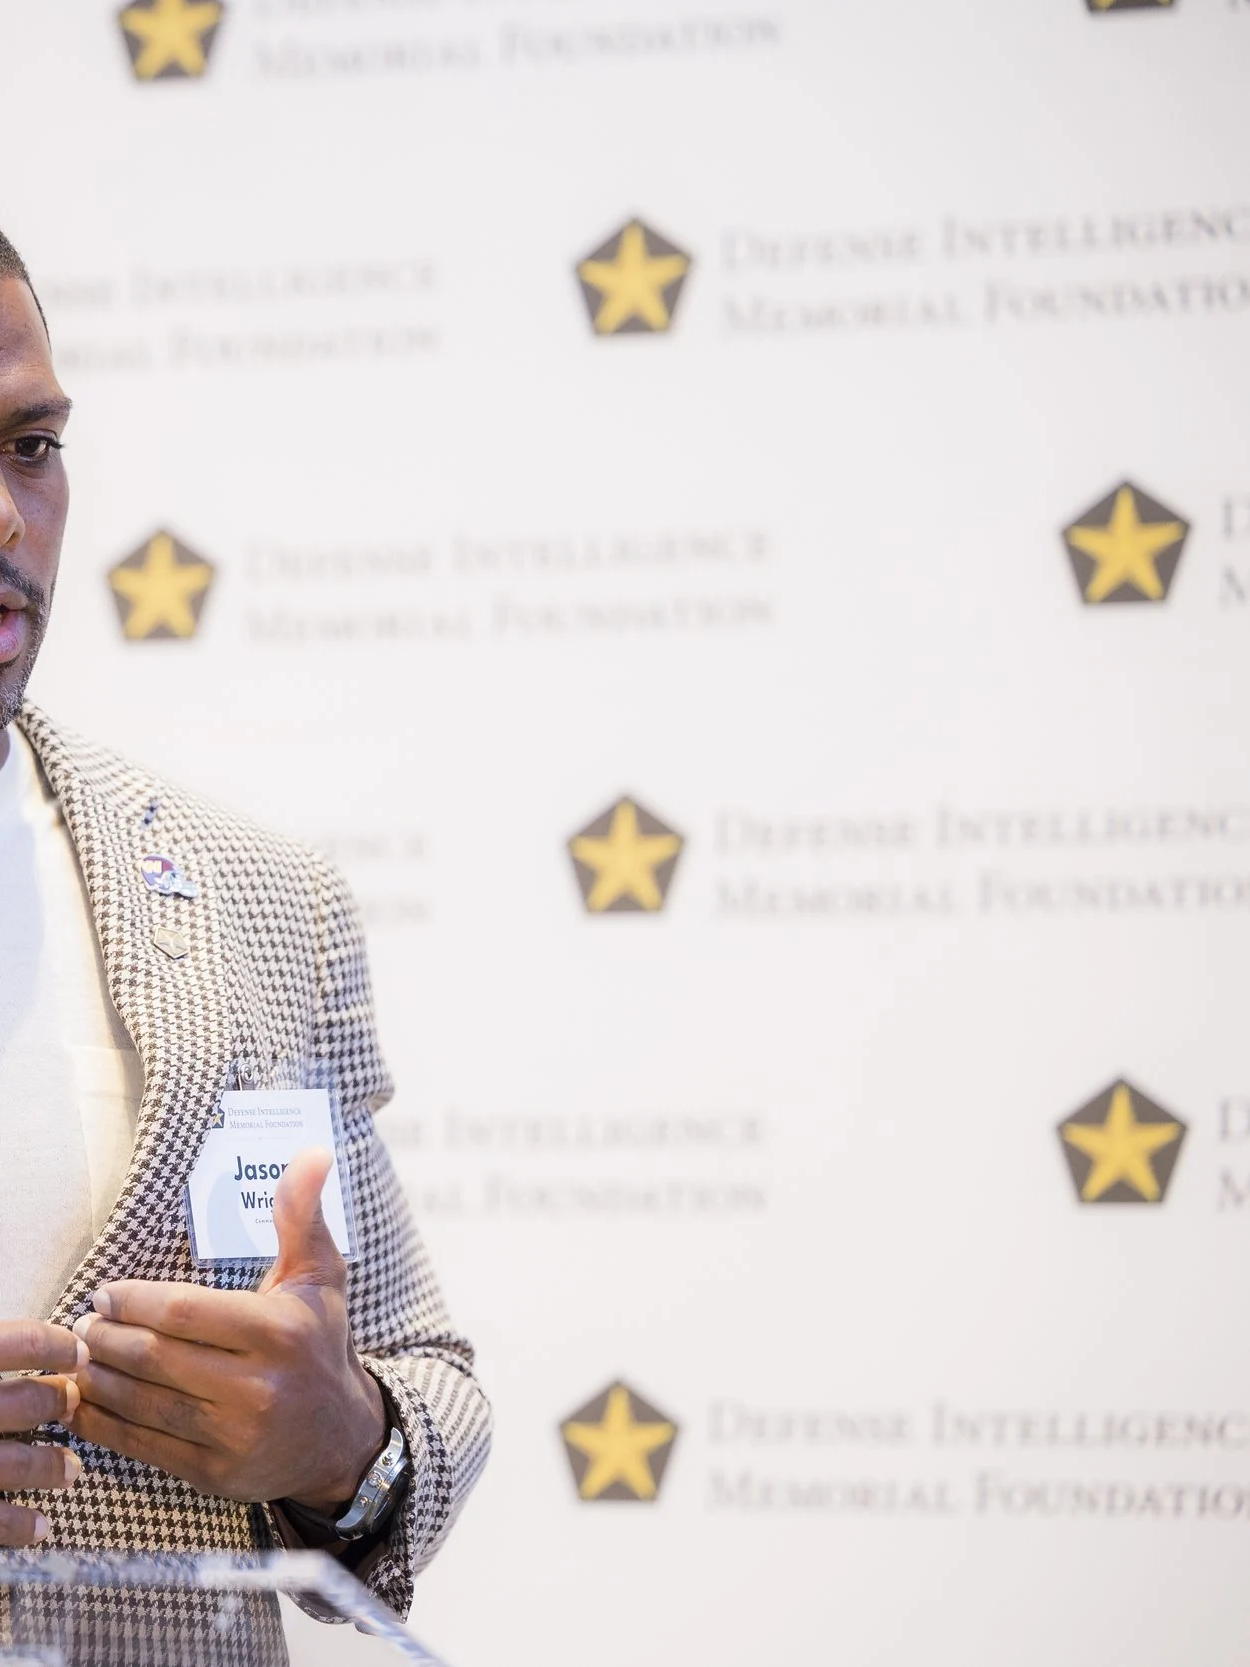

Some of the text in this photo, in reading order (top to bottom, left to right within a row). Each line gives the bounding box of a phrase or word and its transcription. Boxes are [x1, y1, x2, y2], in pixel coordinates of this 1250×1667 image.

[943, 203, 1250, 258] INTELLIGENC
[984, 276, 1250, 322] FOUNDATIO
[936, 806, 1250, 848] INTELLIGENC
[979, 872, 1250, 913] FOUNDATIO
[709, 1401, 1250, 1449] DEFENSE INTELLIGENC
[709, 1469, 1250, 1519] MEMORIAL FOUNDATIO
